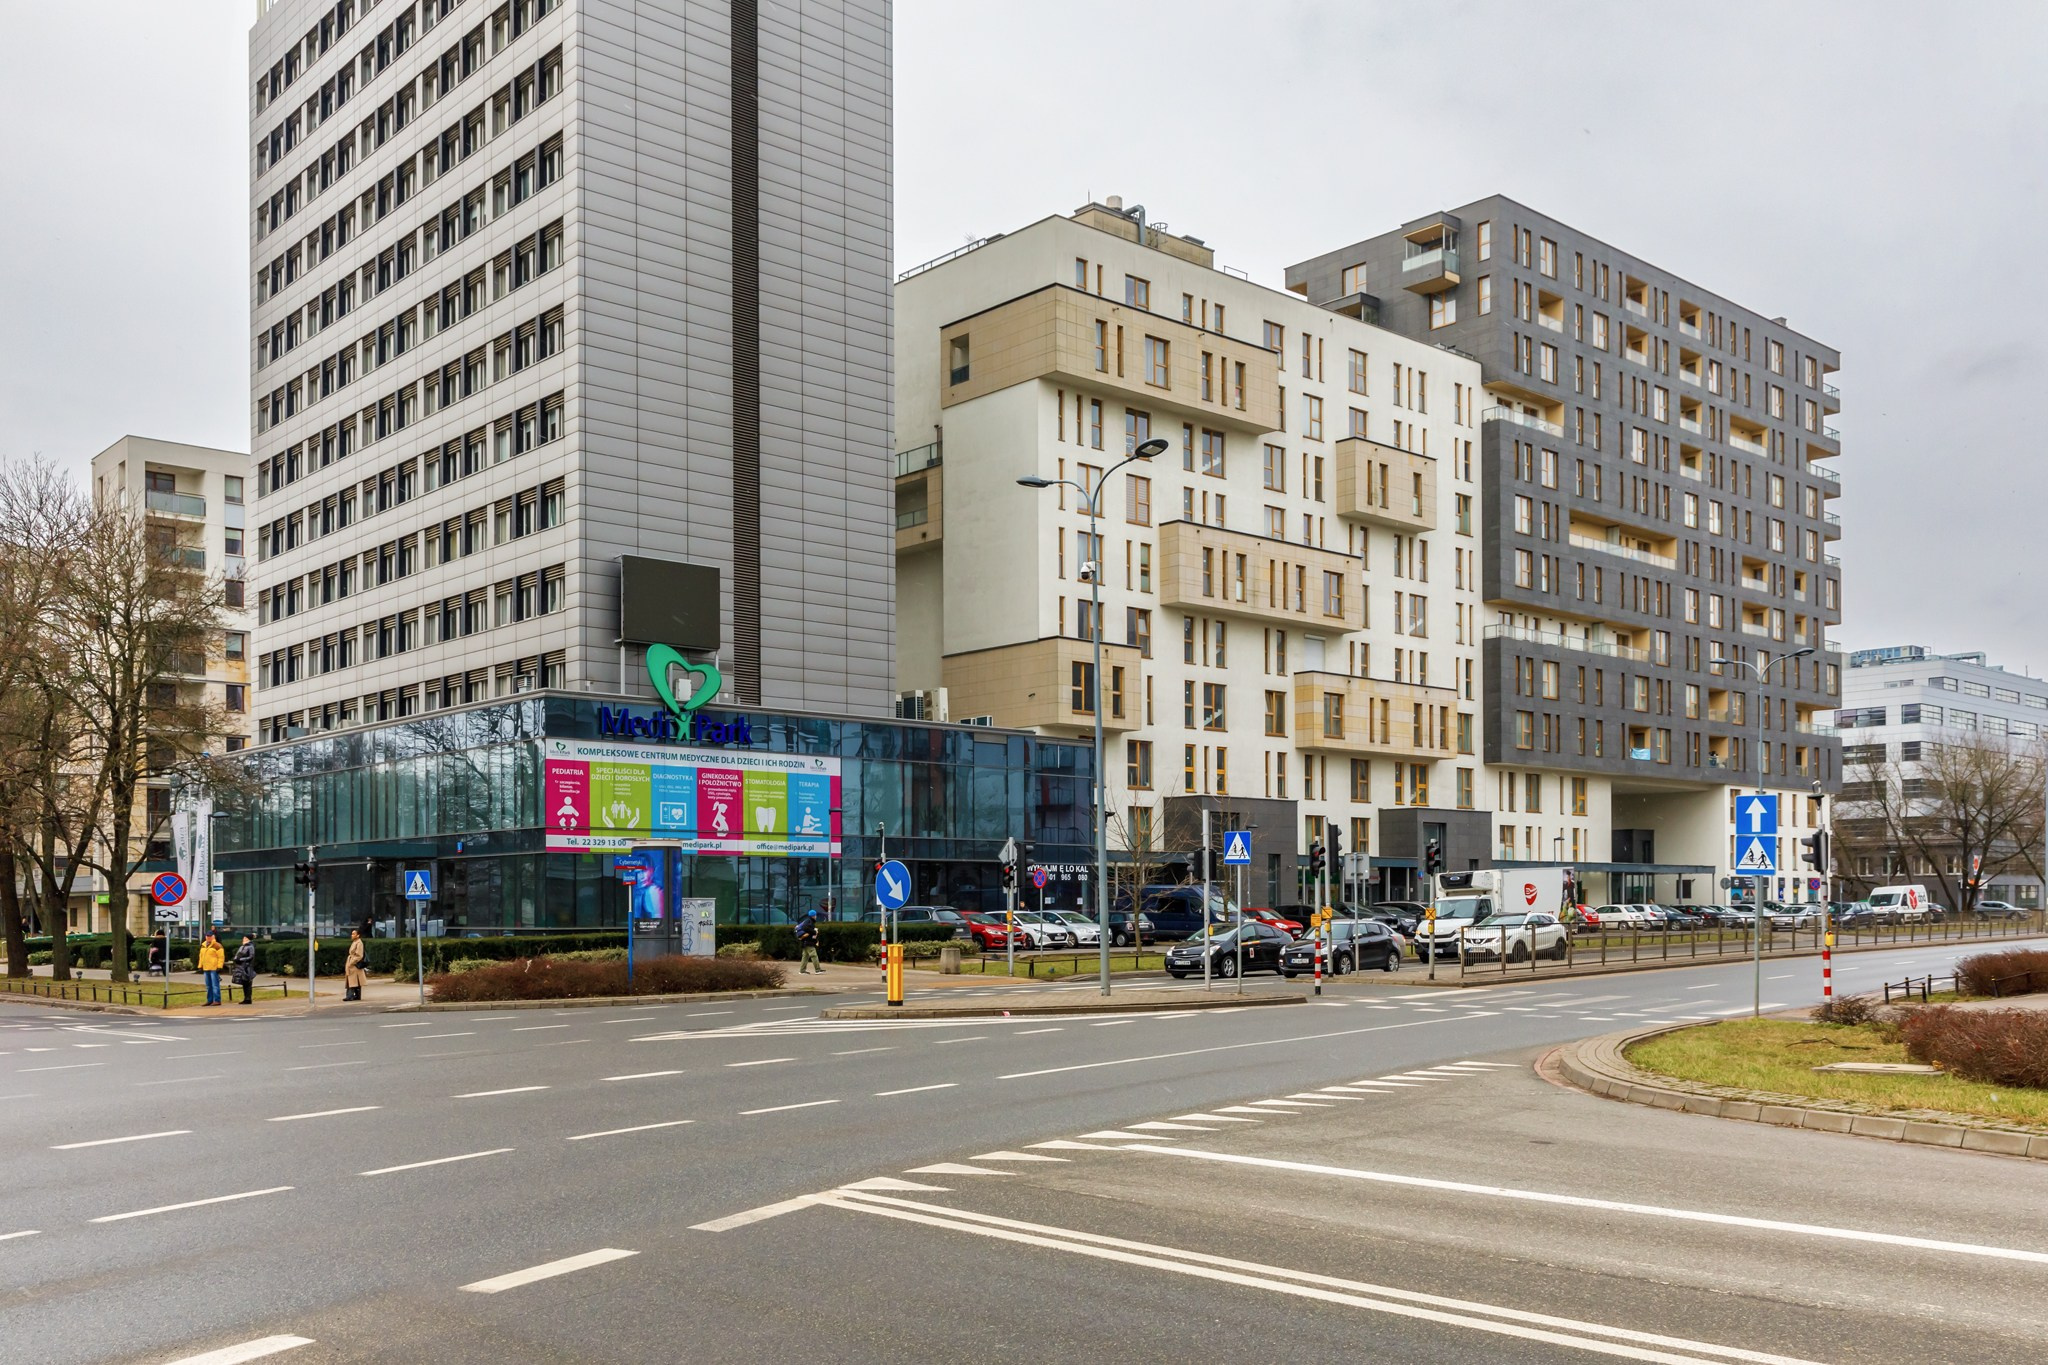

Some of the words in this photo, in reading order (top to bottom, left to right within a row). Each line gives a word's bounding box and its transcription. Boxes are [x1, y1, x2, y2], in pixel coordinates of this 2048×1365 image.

[602, 706, 671, 739] Medi
[695, 714, 753, 744] Park
[577, 747, 639, 758] KOMPLEKSOWE
[641, 751, 678, 760] CENTRUM
[680, 752, 720, 763] MEDYCZNE
[721, 756, 736, 764] DLA
[737, 757, 760, 766] DZIECI
[761, 758, 764, 766] I
[765, 758, 777, 767] ICH
[779, 759, 805, 768] RODZIN
[552, 767, 584, 776] PEDIATRIA
[615, 774, 650, 782] DOROSŁYCH
[653, 773, 693, 781] DIAGNOSTYKA
[702, 772, 738, 780] GINEKOLOGIA
[702, 779, 742, 787] POŁOŻNICTWO
[745, 778, 786, 786] STOMATOLOGIA
[582, 838, 591, 846] 22
[592, 838, 606, 846] 329
[617, 839, 627, 847] 00
[756, 843, 815, 851] office@medipark.pl
